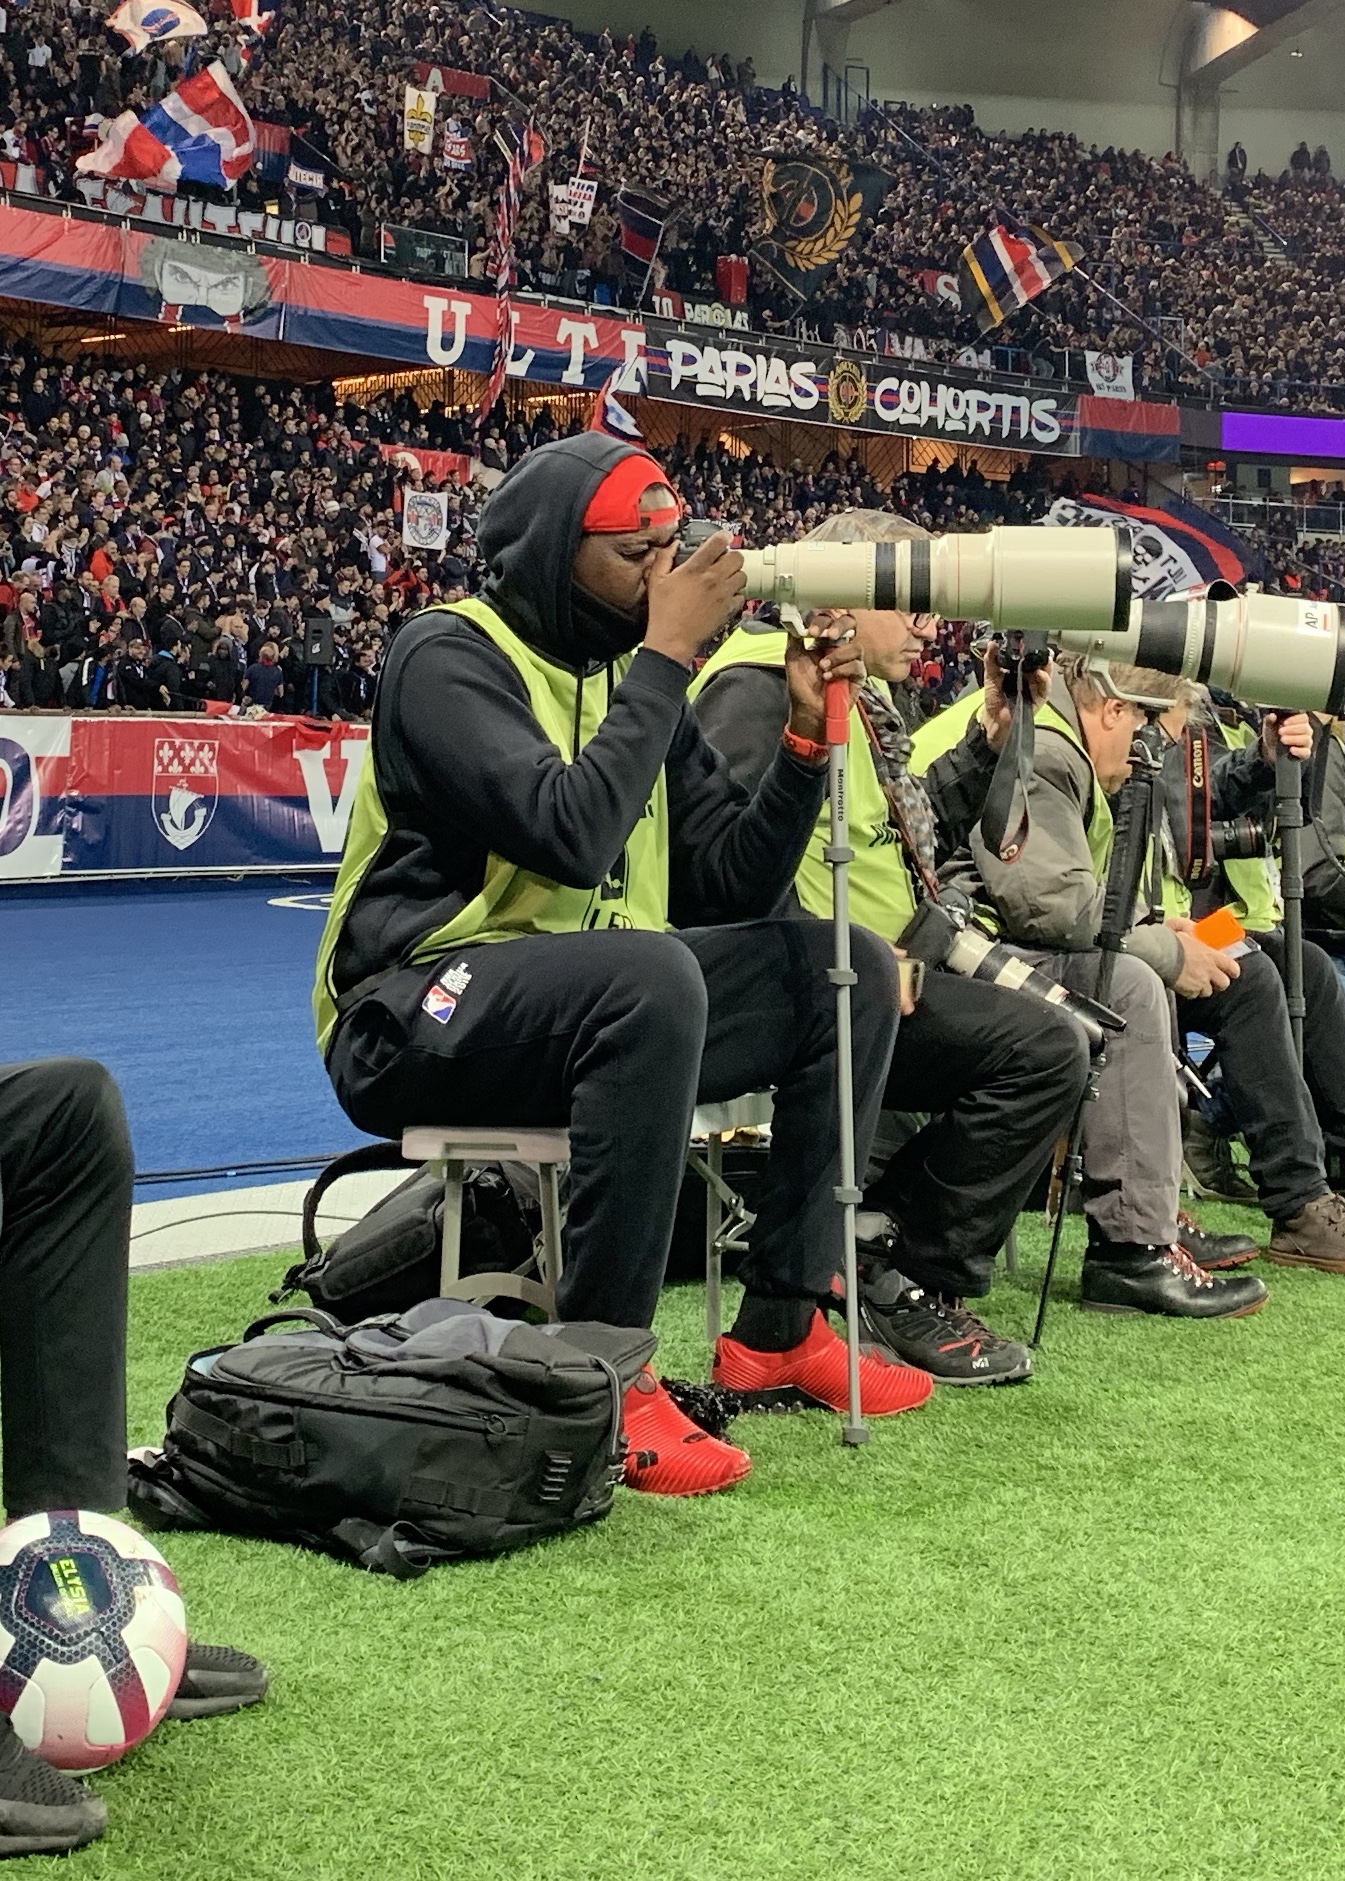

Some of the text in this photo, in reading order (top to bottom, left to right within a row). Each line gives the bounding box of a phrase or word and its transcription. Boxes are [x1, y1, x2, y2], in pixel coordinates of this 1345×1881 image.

[665, 339, 820, 410] PARIAS
[874, 376, 1061, 443] COHORTIS
[1192, 739, 1204, 788] Canon
[1190, 858, 1203, 880] non
